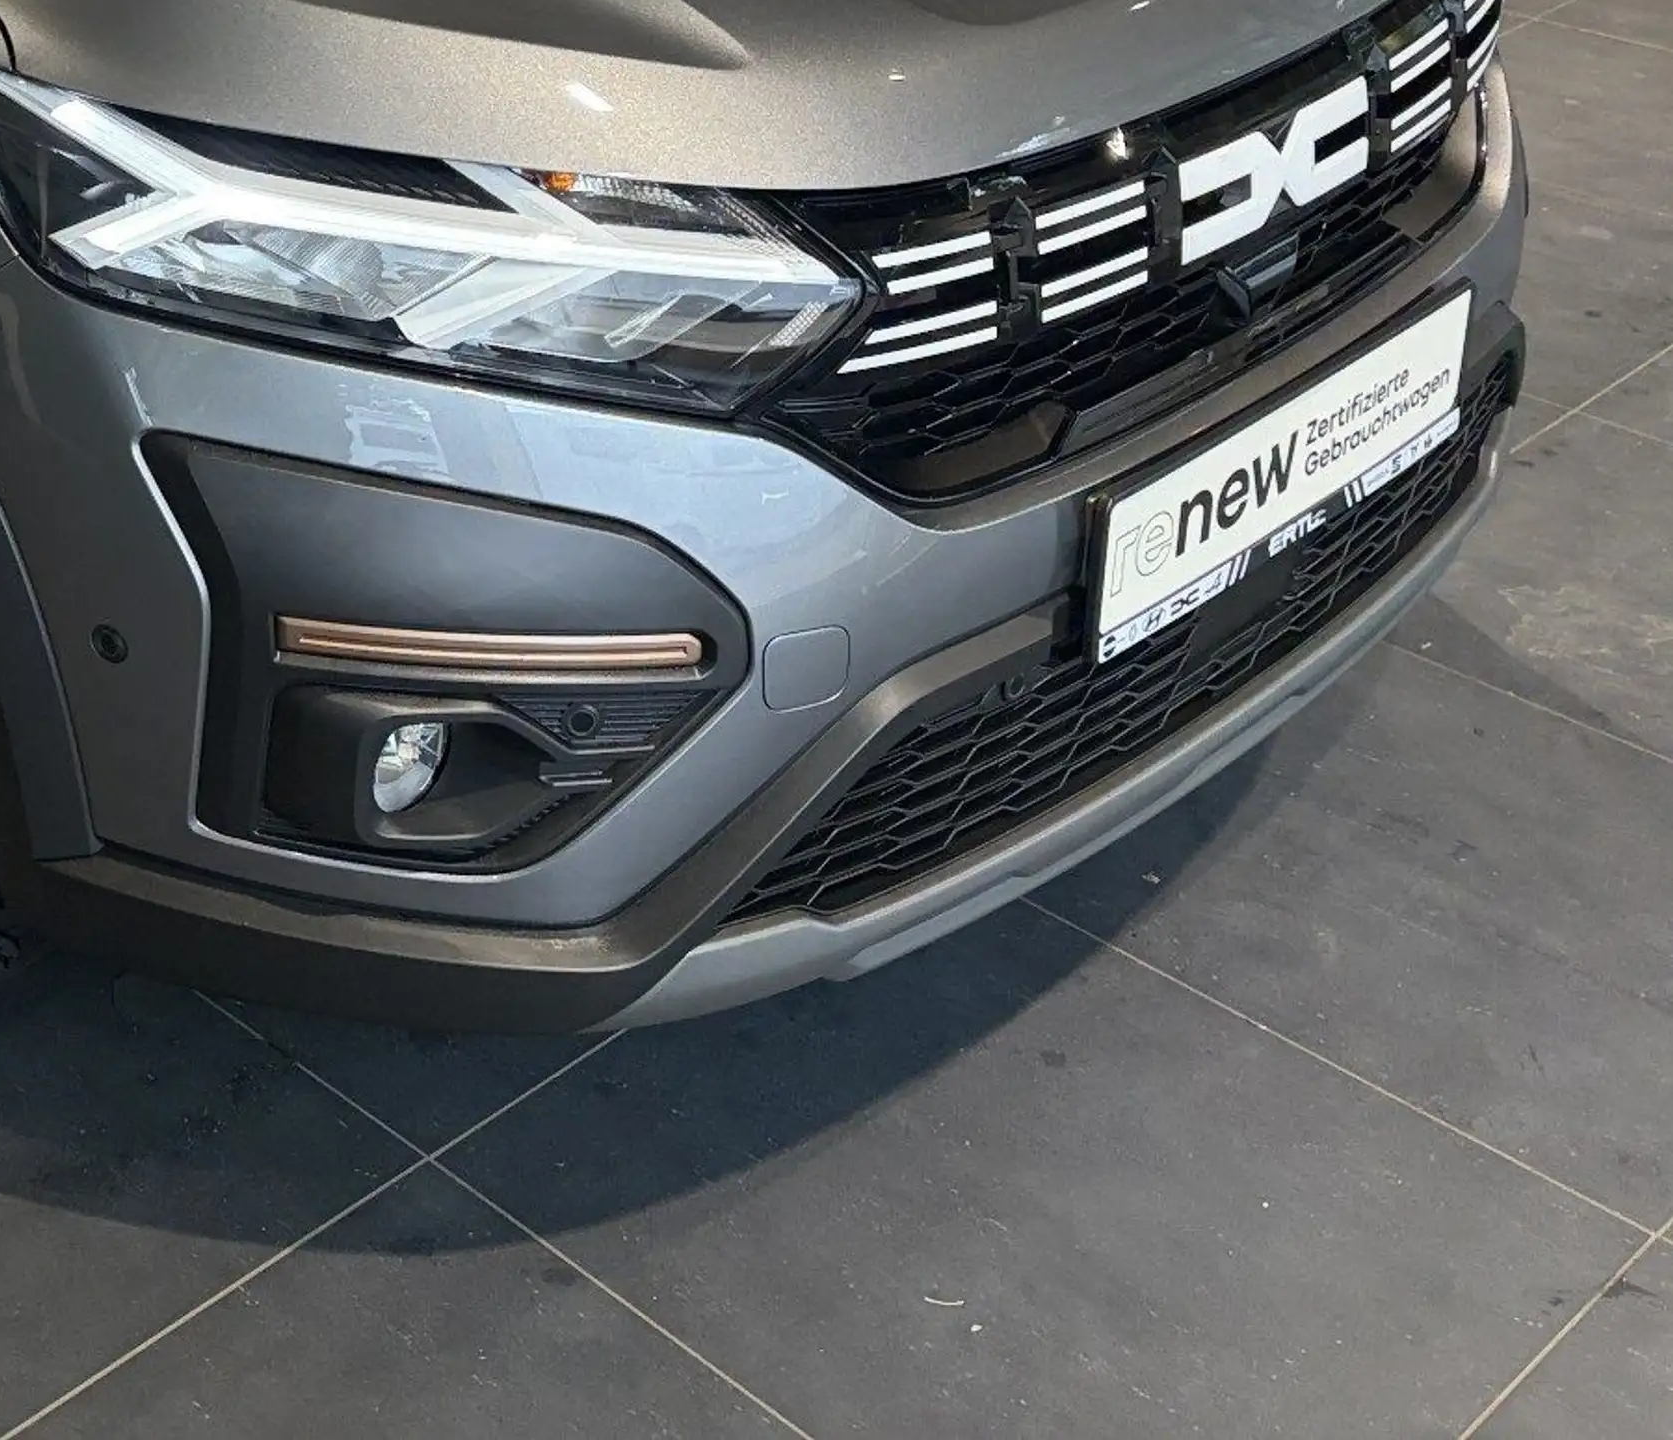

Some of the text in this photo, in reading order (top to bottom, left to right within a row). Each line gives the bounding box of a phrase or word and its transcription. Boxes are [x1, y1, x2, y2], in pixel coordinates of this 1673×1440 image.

[1304, 368, 1451, 477] Gebrauchtwagen
[1305, 368, 1410, 446] Zertifizierte
[1109, 429, 1299, 598] renew
